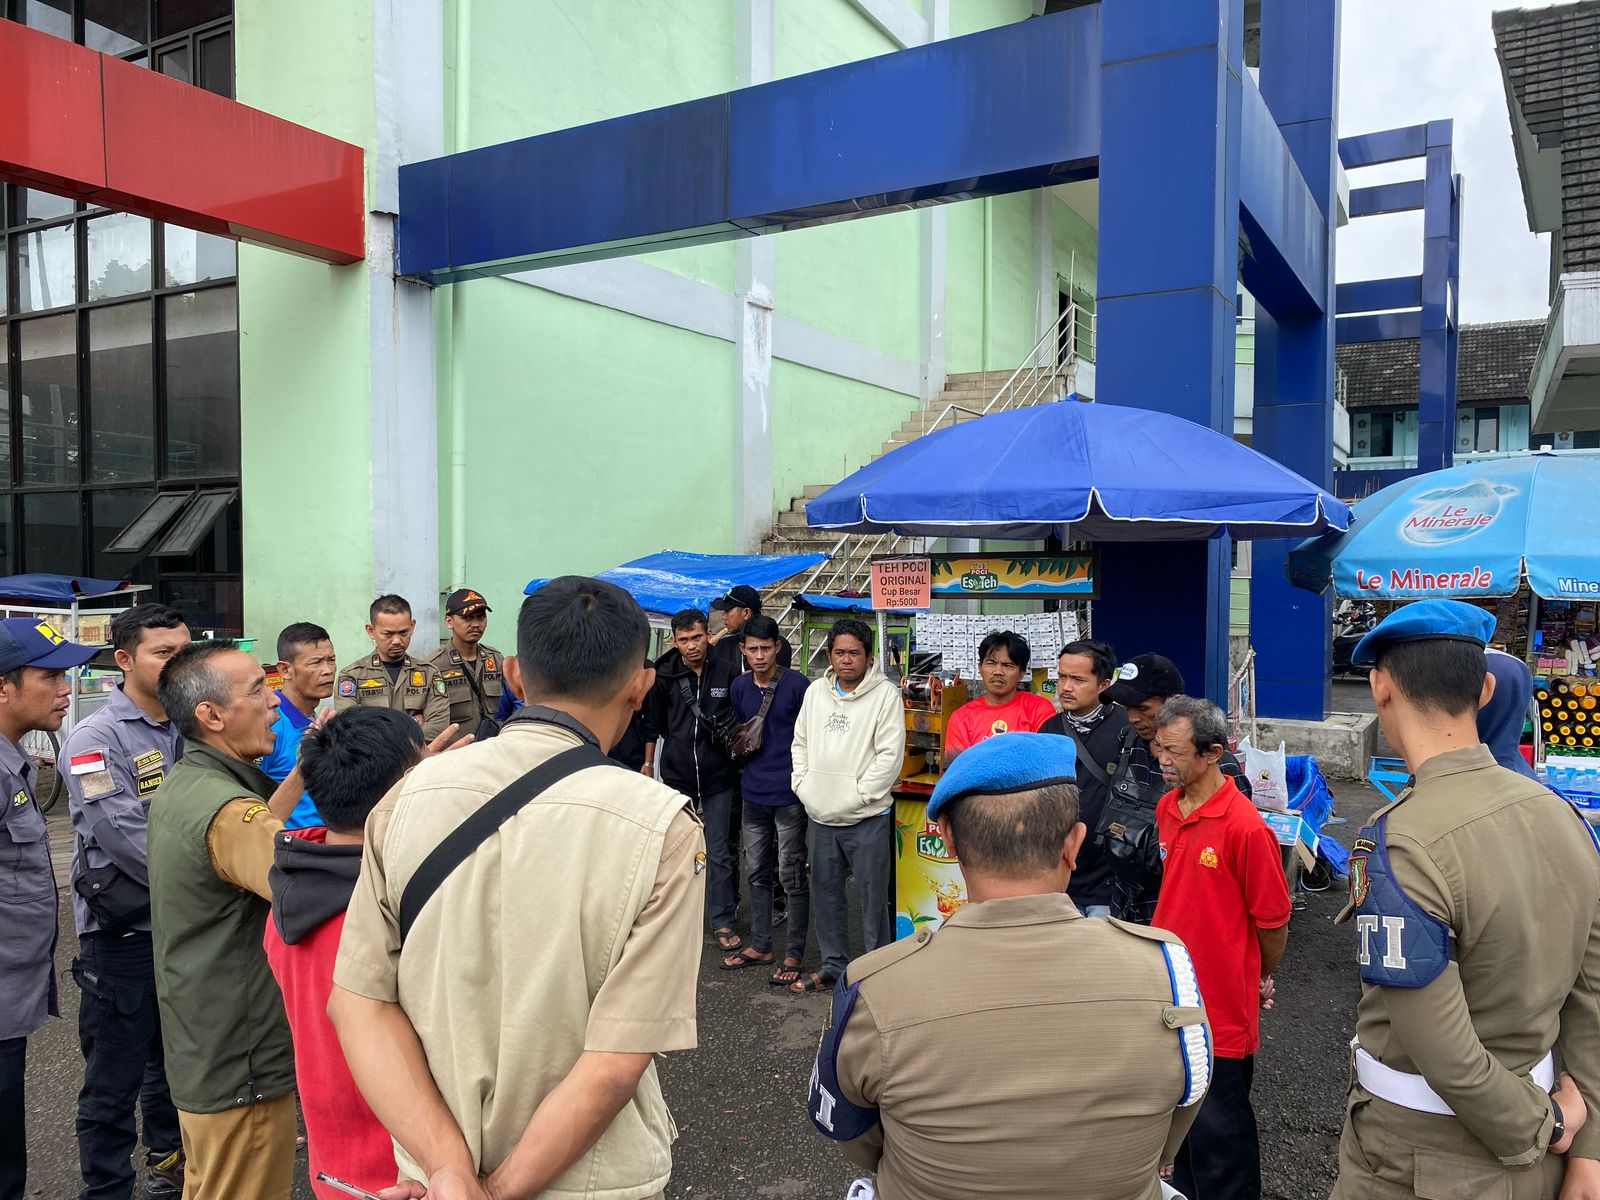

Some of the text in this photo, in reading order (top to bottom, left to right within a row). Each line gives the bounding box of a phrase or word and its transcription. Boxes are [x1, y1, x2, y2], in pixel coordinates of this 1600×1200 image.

[1442, 505, 1468, 518] Le
[1404, 513, 1493, 529] Minerale
[879, 561, 927, 573] TEH POCI
[880, 575, 927, 586] ORIGINAL
[962, 575, 997, 589] Es Teh
[1356, 566, 1493, 590] Le Minerale
[1558, 577, 1600, 594] Mine
[881, 588, 921, 597] Cup Besar
